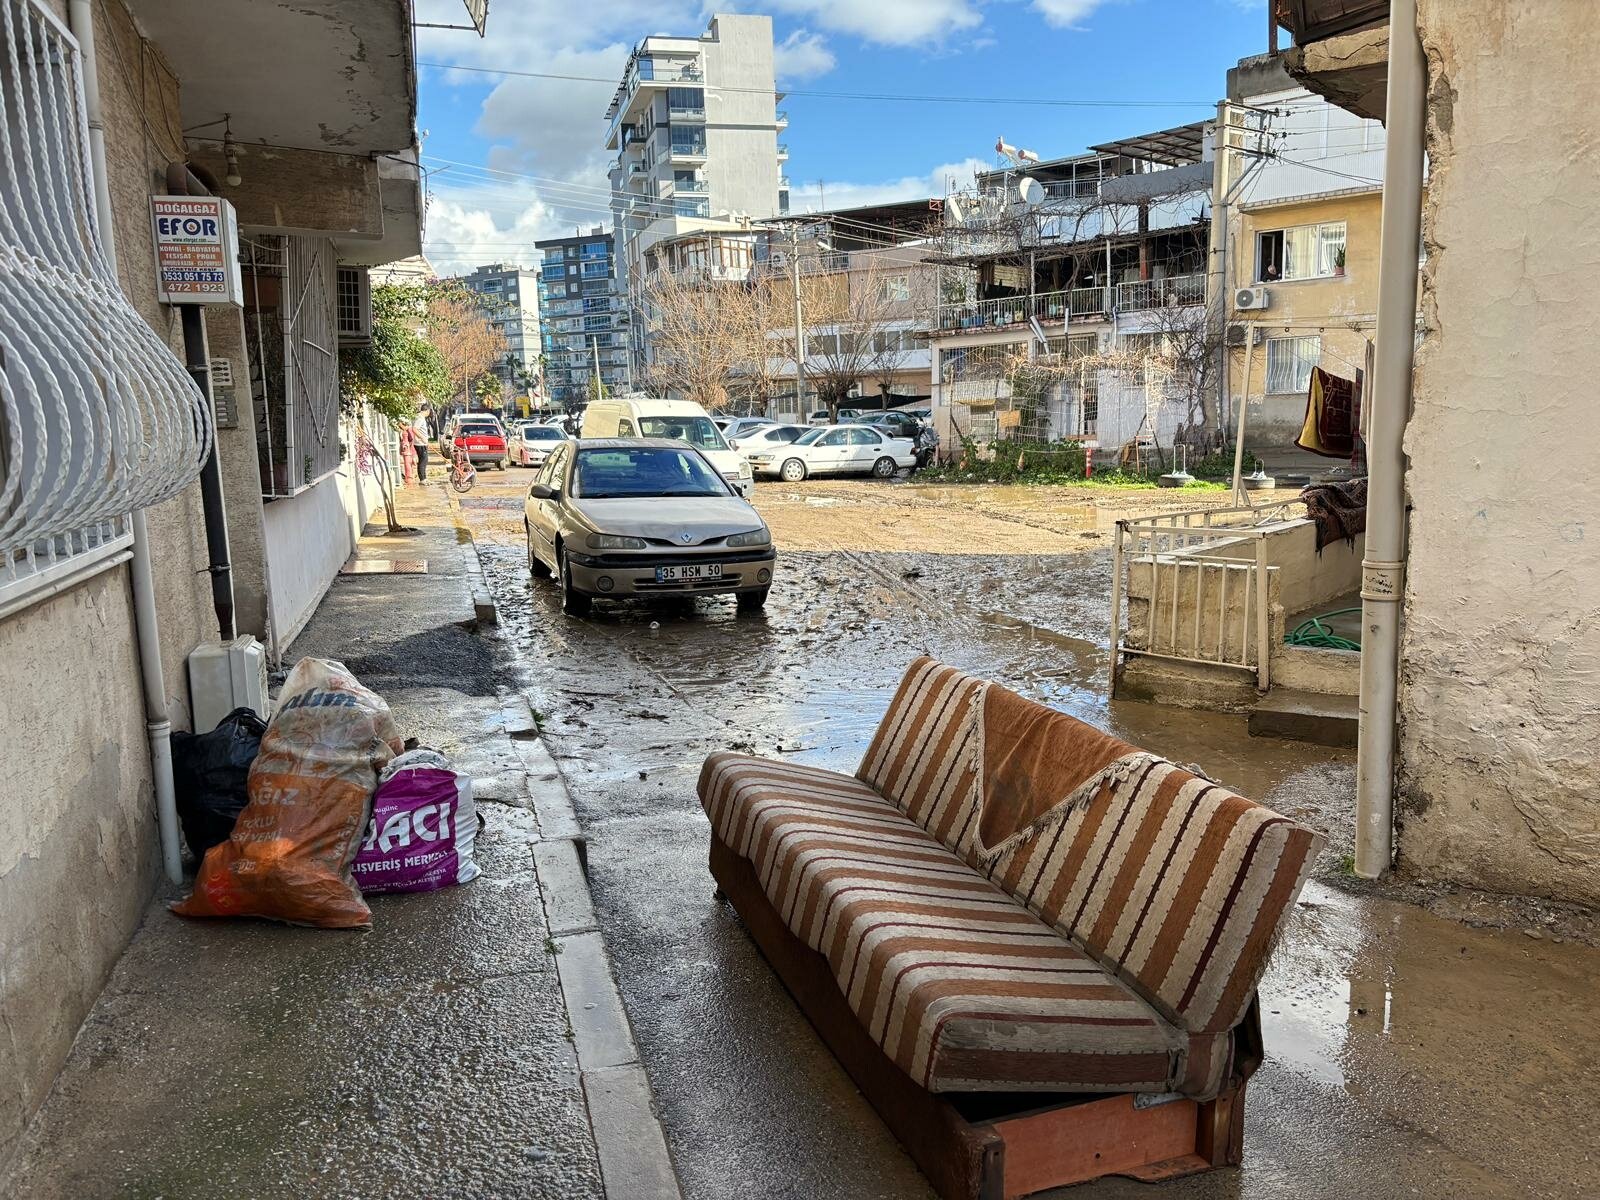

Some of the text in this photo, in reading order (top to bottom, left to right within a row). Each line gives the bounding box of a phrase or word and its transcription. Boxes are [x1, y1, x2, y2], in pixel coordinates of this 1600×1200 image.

[155, 203, 216, 214] DOĞALGAZ
[158, 217, 217, 236] EFOR
[184, 272, 199, 281] 051
[201, 273, 211, 281] 75
[212, 273, 223, 281] 73
[168, 283, 225, 292] 472 1923
[663, 564, 720, 578] 35 HSM 50
